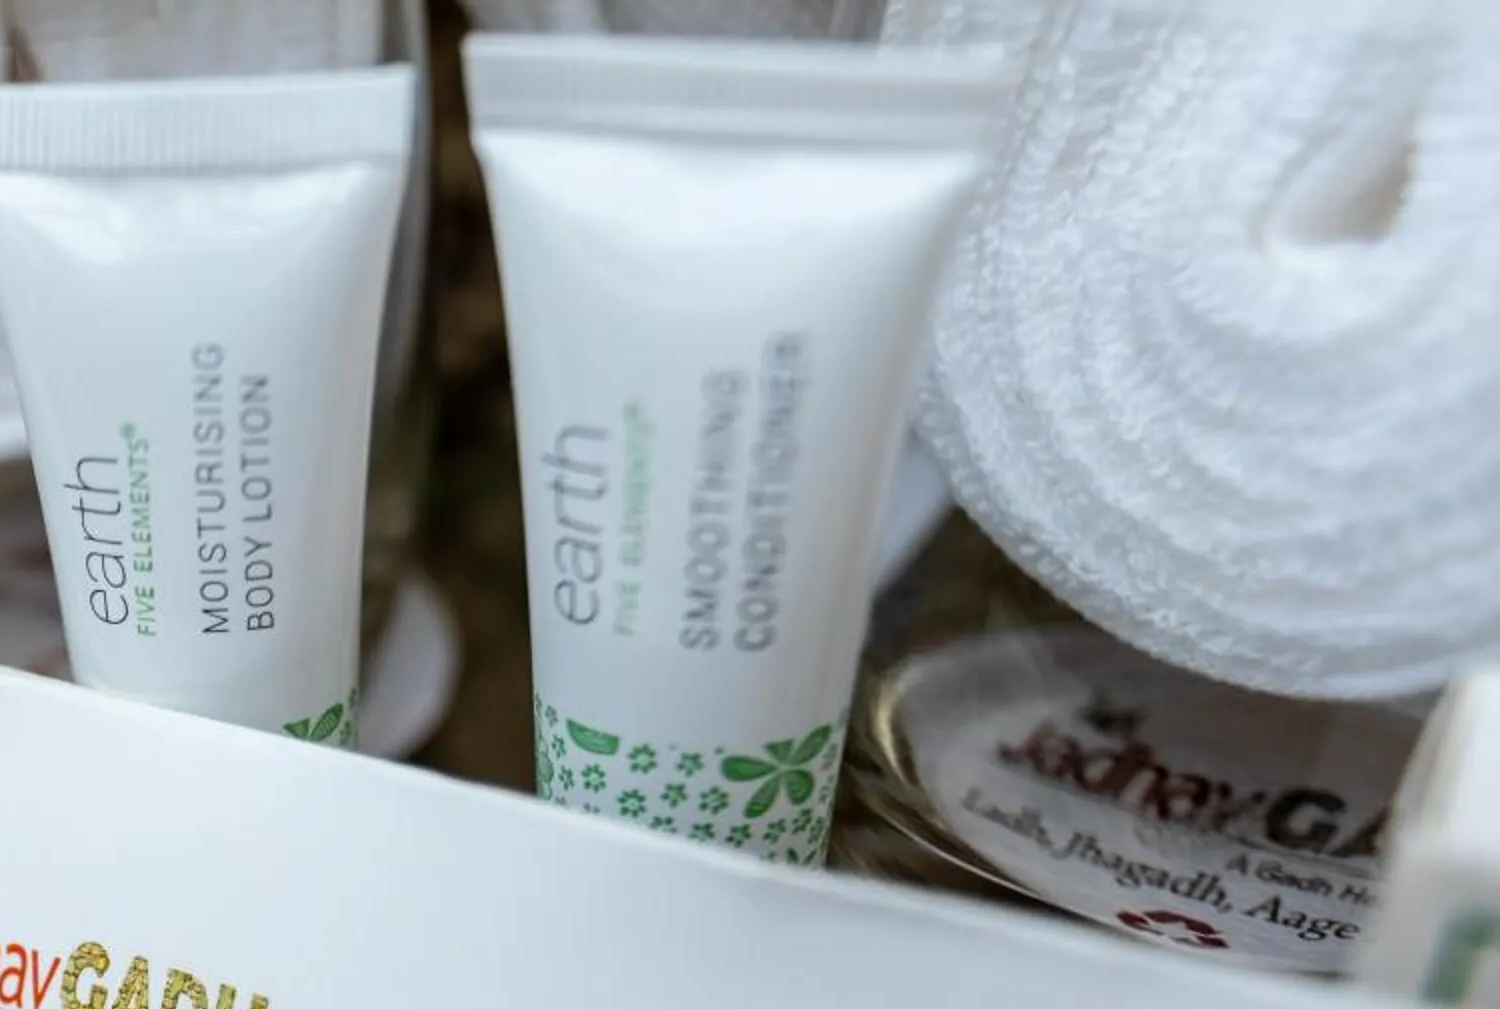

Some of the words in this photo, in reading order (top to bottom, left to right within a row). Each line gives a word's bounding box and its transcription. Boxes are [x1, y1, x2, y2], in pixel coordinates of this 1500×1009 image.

[192, 342, 230, 634] MOISTURISING
[239, 373, 274, 524] LOTION
[541, 422, 610, 626] earth
[678, 367, 748, 653] SMOOTHING
[733, 329, 808, 654] CONDITIONER
[63, 454, 129, 626] earth
[133, 587, 157, 638] FIVE
[243, 536, 275, 632] BODY
[1246, 893, 1361, 942] Aage
